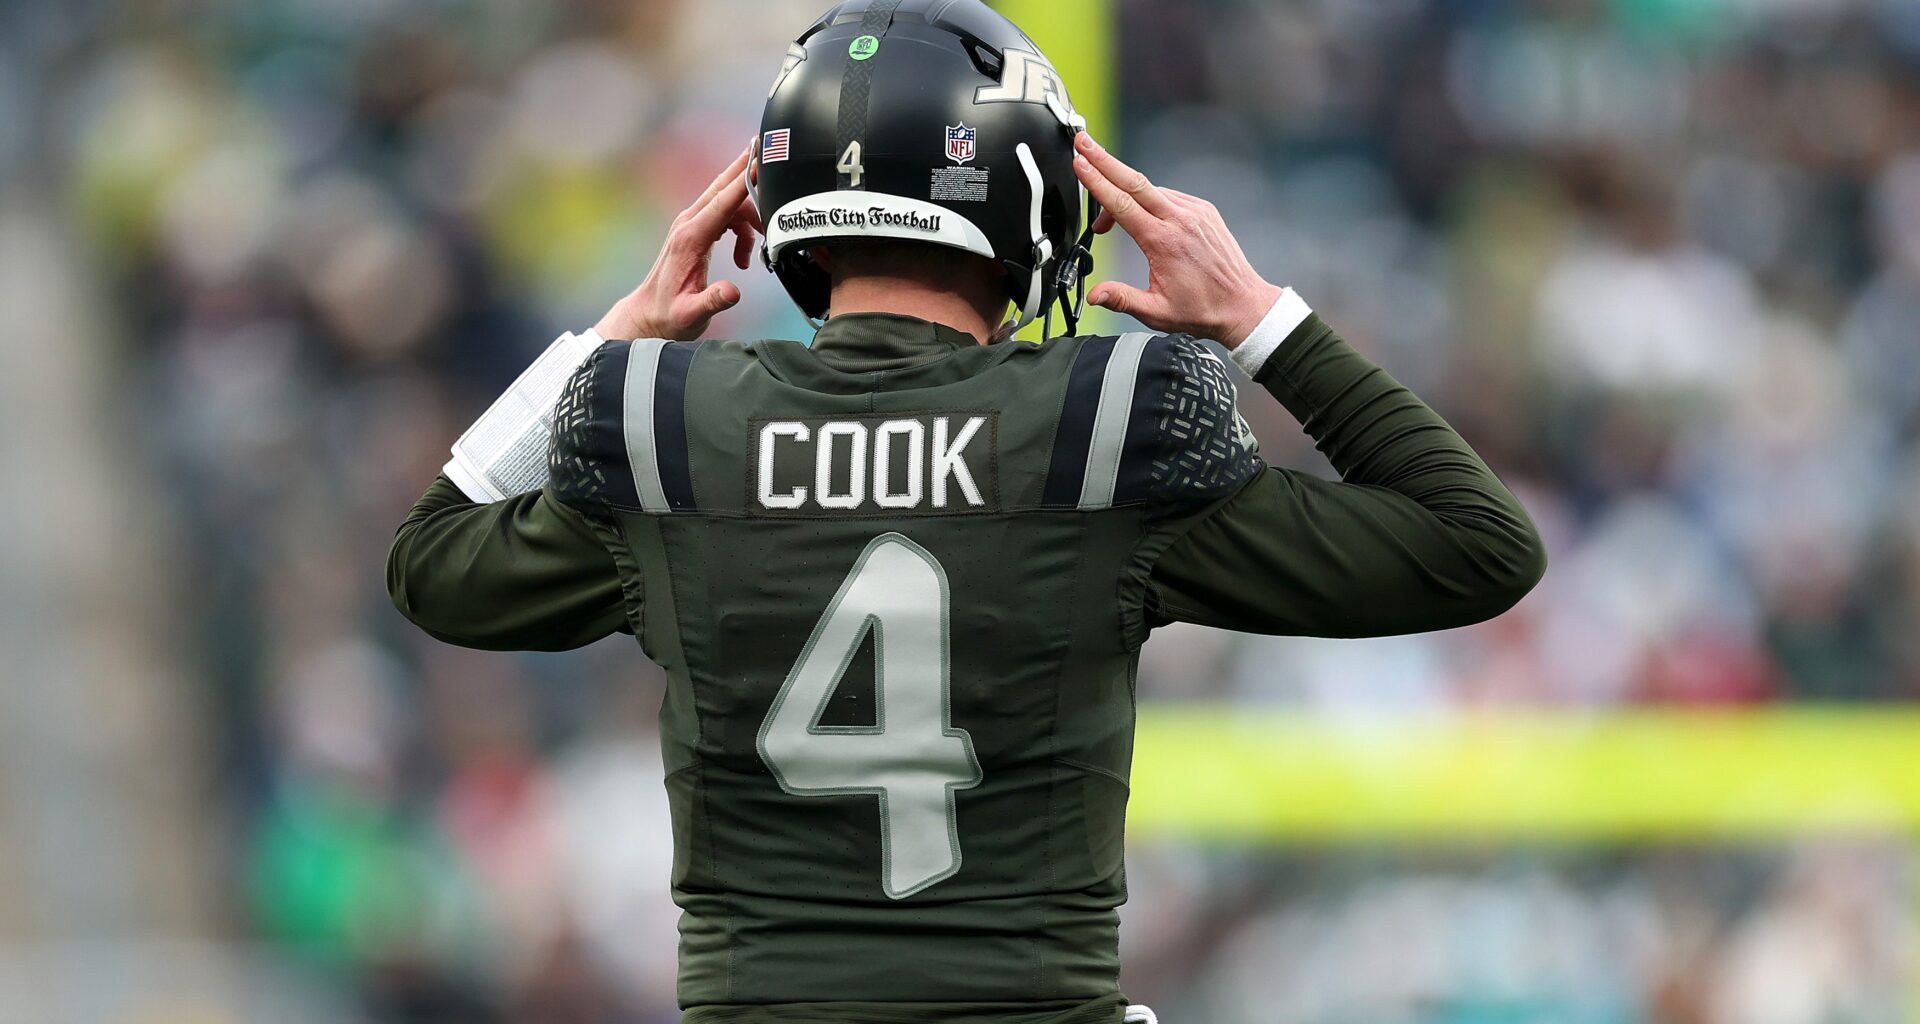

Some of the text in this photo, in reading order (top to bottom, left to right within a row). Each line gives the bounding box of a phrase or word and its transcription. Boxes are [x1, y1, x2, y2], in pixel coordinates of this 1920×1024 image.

[837, 140, 864, 187] 4
[950, 140, 972, 157] NFL
[778, 206, 941, 232] Gotham City Football
[757, 416, 988, 510] COOK
[757, 531, 983, 900] 4
